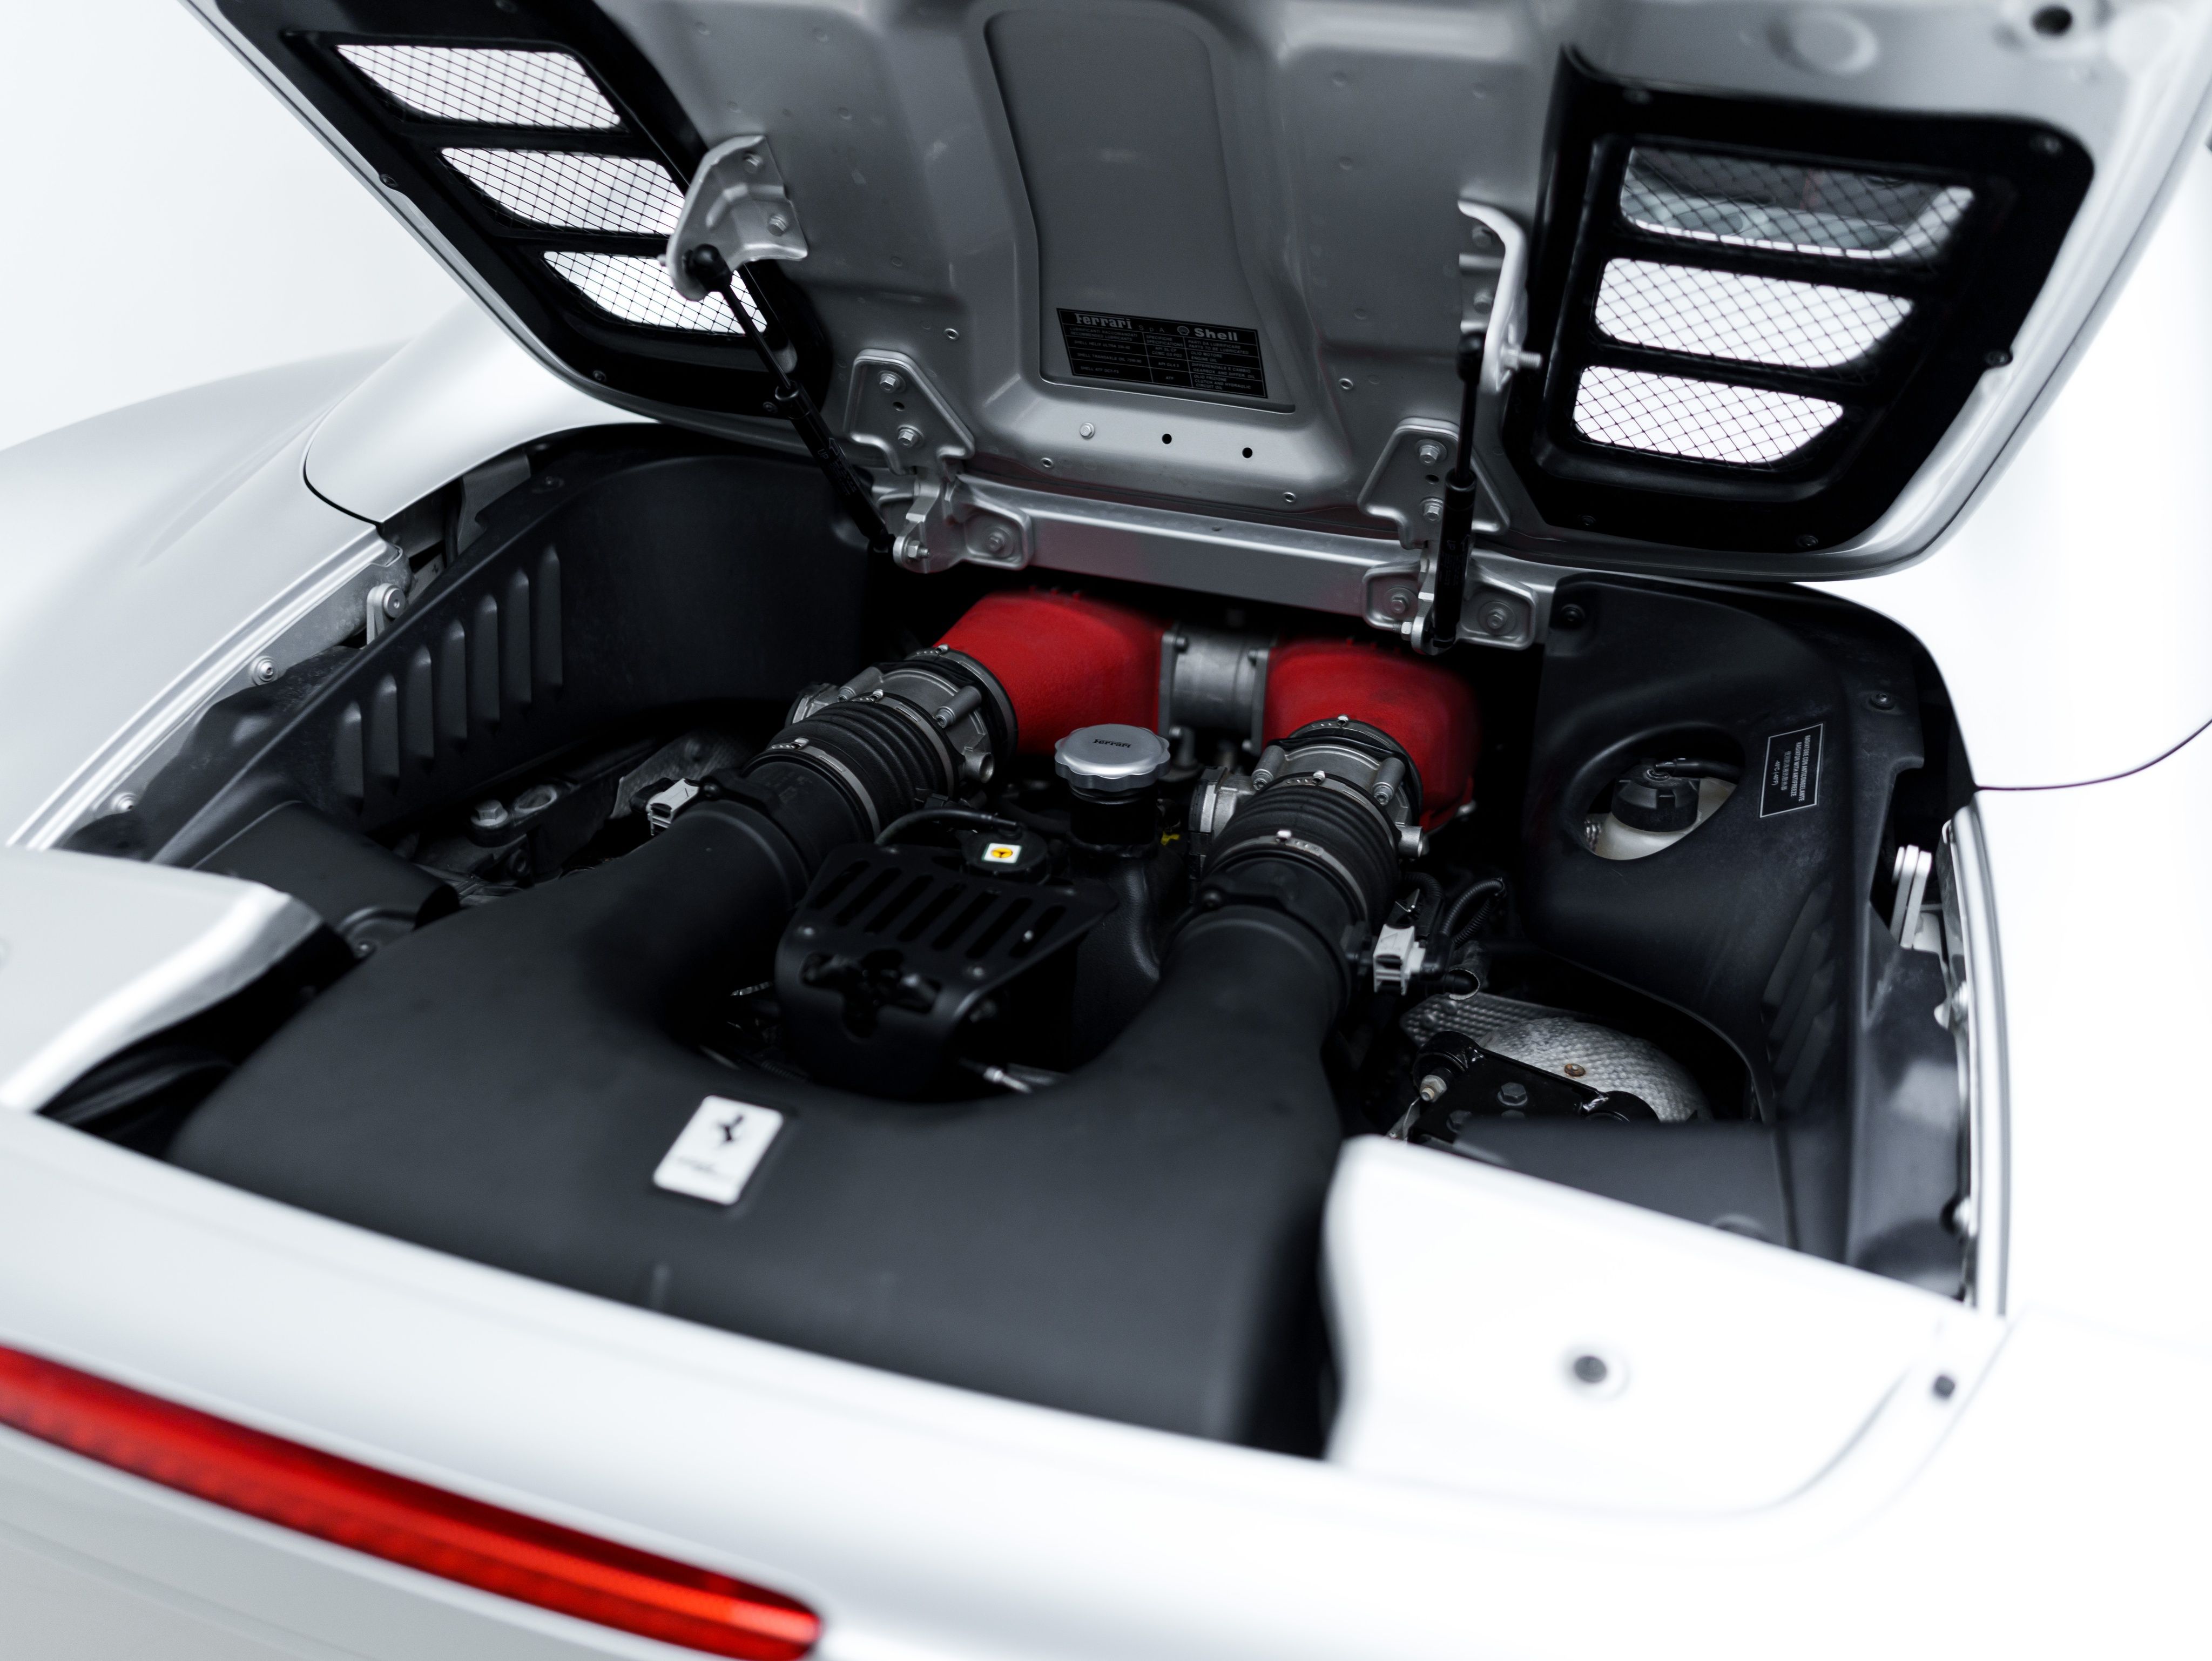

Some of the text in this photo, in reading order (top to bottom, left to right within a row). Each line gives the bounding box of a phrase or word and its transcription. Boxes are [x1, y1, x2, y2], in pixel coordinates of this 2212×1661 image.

[1075, 313, 1132, 329] Ferrari
[1194, 327, 1238, 341] Shell
[1191, 362, 1226, 371] DIFFERENZIALE
[817, 448, 829, 459] UP
[1093, 739, 1132, 748] Ferrari
[1803, 735, 1811, 757] RADIATORE
[1791, 772, 1799, 797] ANTIFREEZE
[1798, 765, 1808, 802] ANTICONGELANTE
